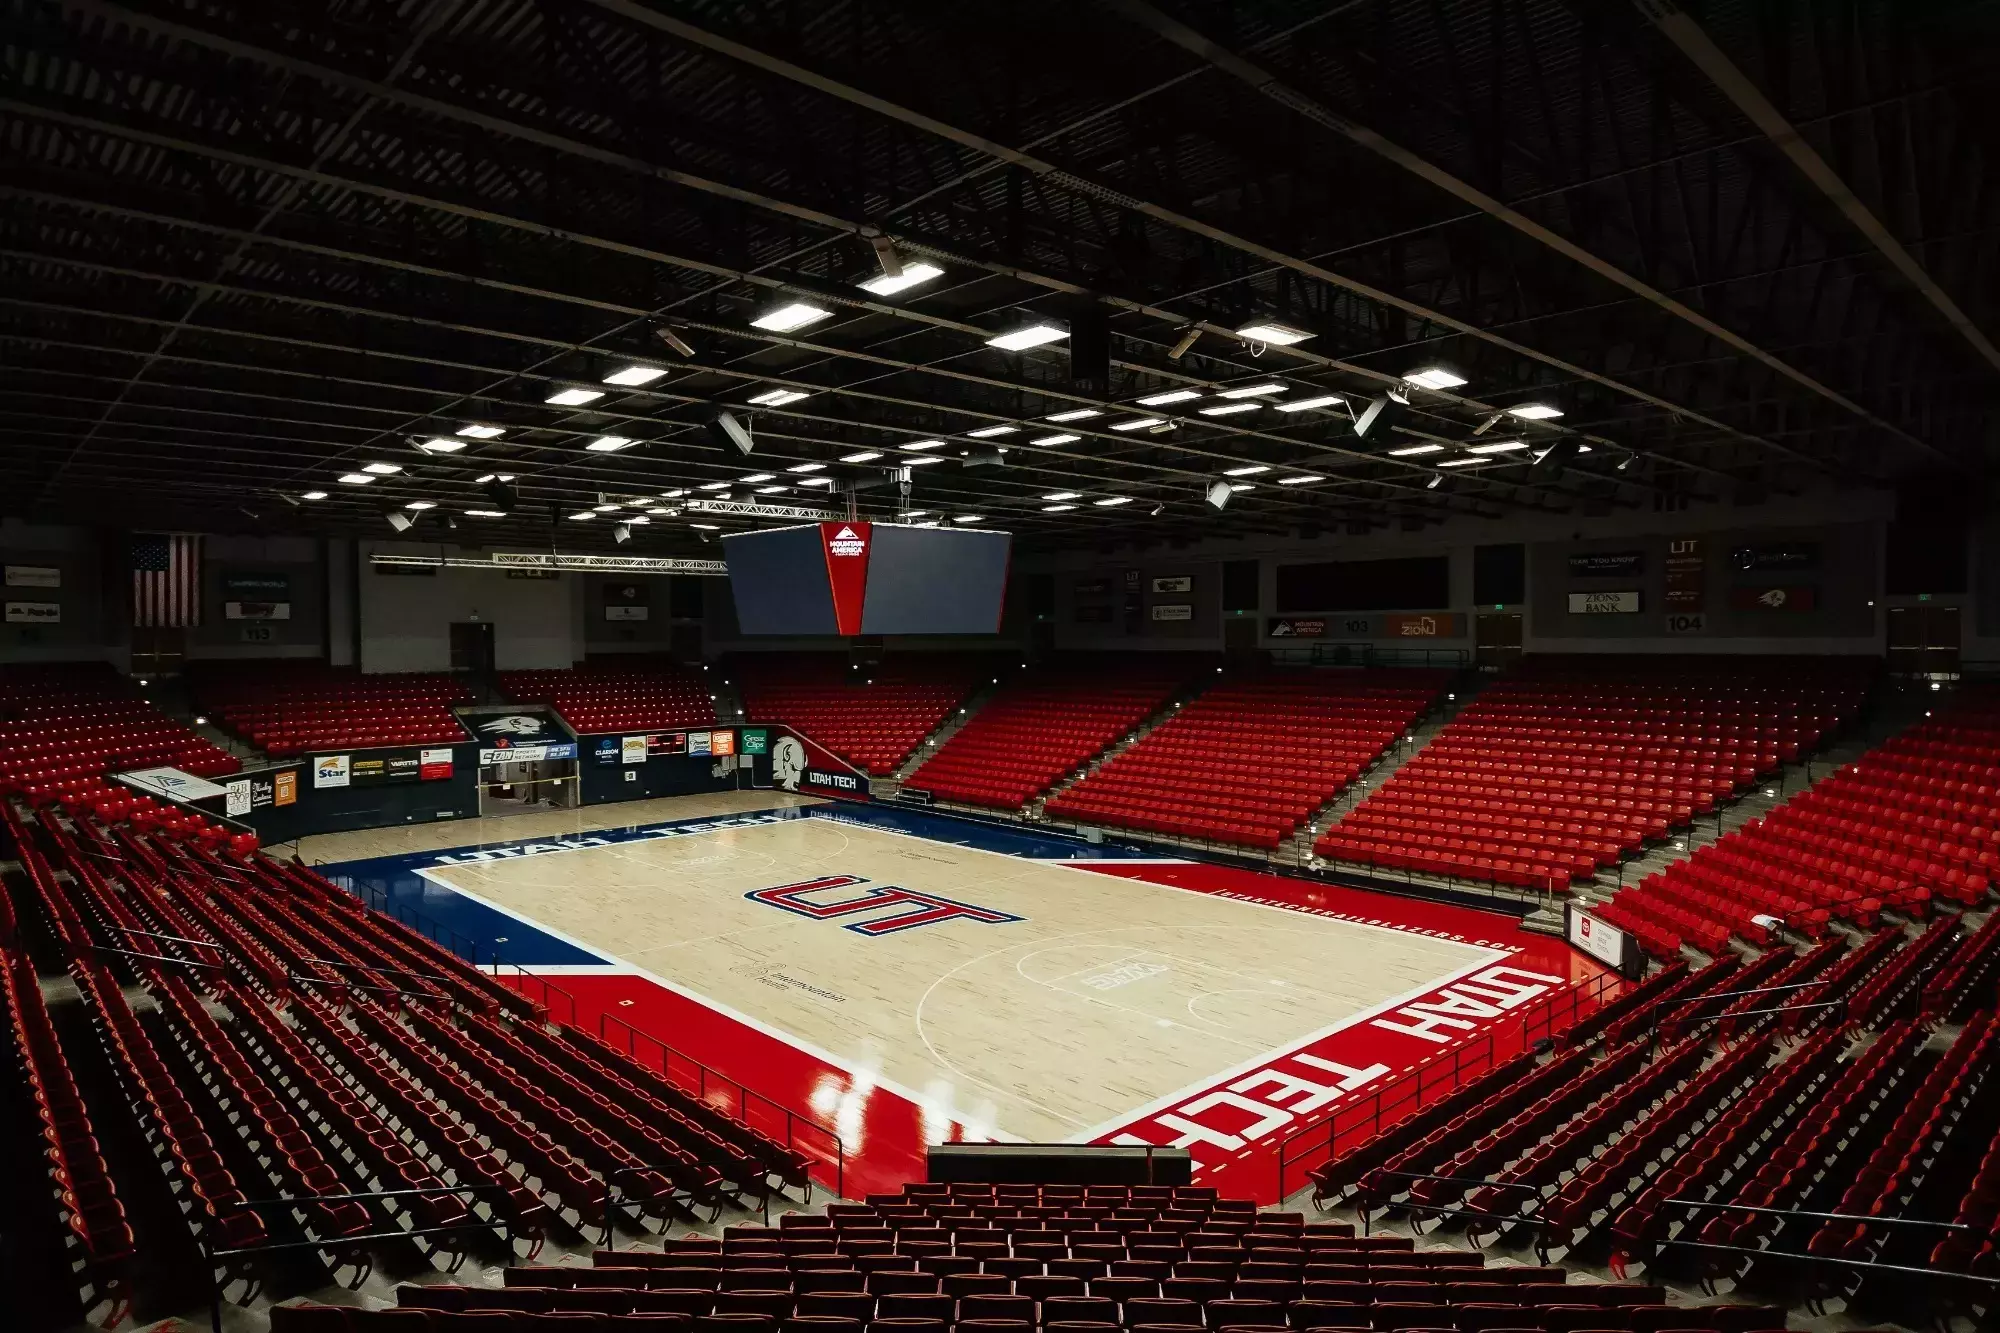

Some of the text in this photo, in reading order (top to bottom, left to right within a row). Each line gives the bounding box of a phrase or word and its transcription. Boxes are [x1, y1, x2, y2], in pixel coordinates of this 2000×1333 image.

[1671, 541, 1699, 553] UT
[1586, 594, 1620, 602] ZIONS
[1586, 603, 1620, 612] BANK
[1346, 621, 1368, 632] 103
[1668, 617, 1702, 630] 104
[744, 734, 765, 742] Great
[745, 741, 764, 749] Clips
[493, 750, 513, 760] FAN
[319, 769, 346, 778] Star
[810, 772, 856, 789] UTAH TECH
[435, 815, 789, 865] UTAH TECH
[743, 874, 1030, 937] UT
[770, 972, 847, 1003] Intermountain
[1110, 966, 1566, 1172] UTAH TECH
